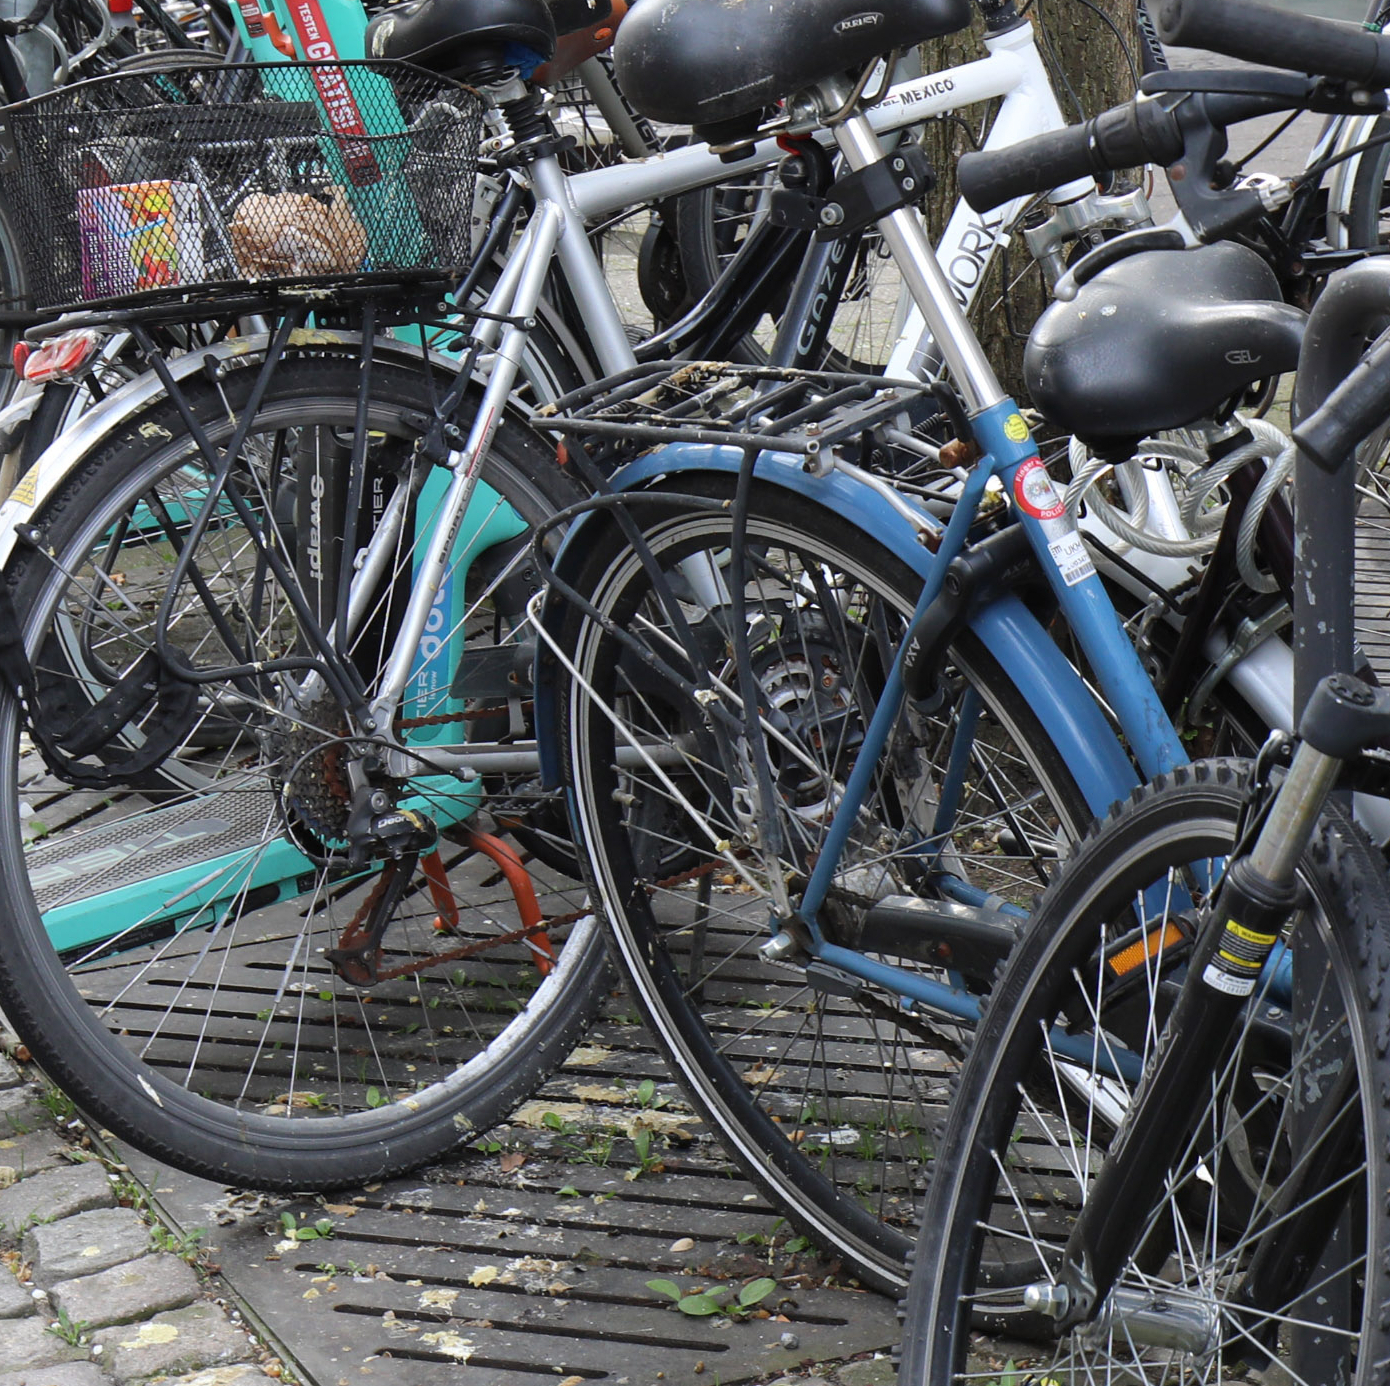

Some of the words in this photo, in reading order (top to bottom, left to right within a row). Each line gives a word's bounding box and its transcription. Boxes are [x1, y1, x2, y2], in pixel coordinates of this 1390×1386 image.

[296, 1, 321, 42] TESTEN
[899, 77, 955, 106] MEXICO
[796, 233, 848, 357] GAZE
[1224, 349, 1262, 365] GEL
[1015, 459, 1037, 483] Finger
